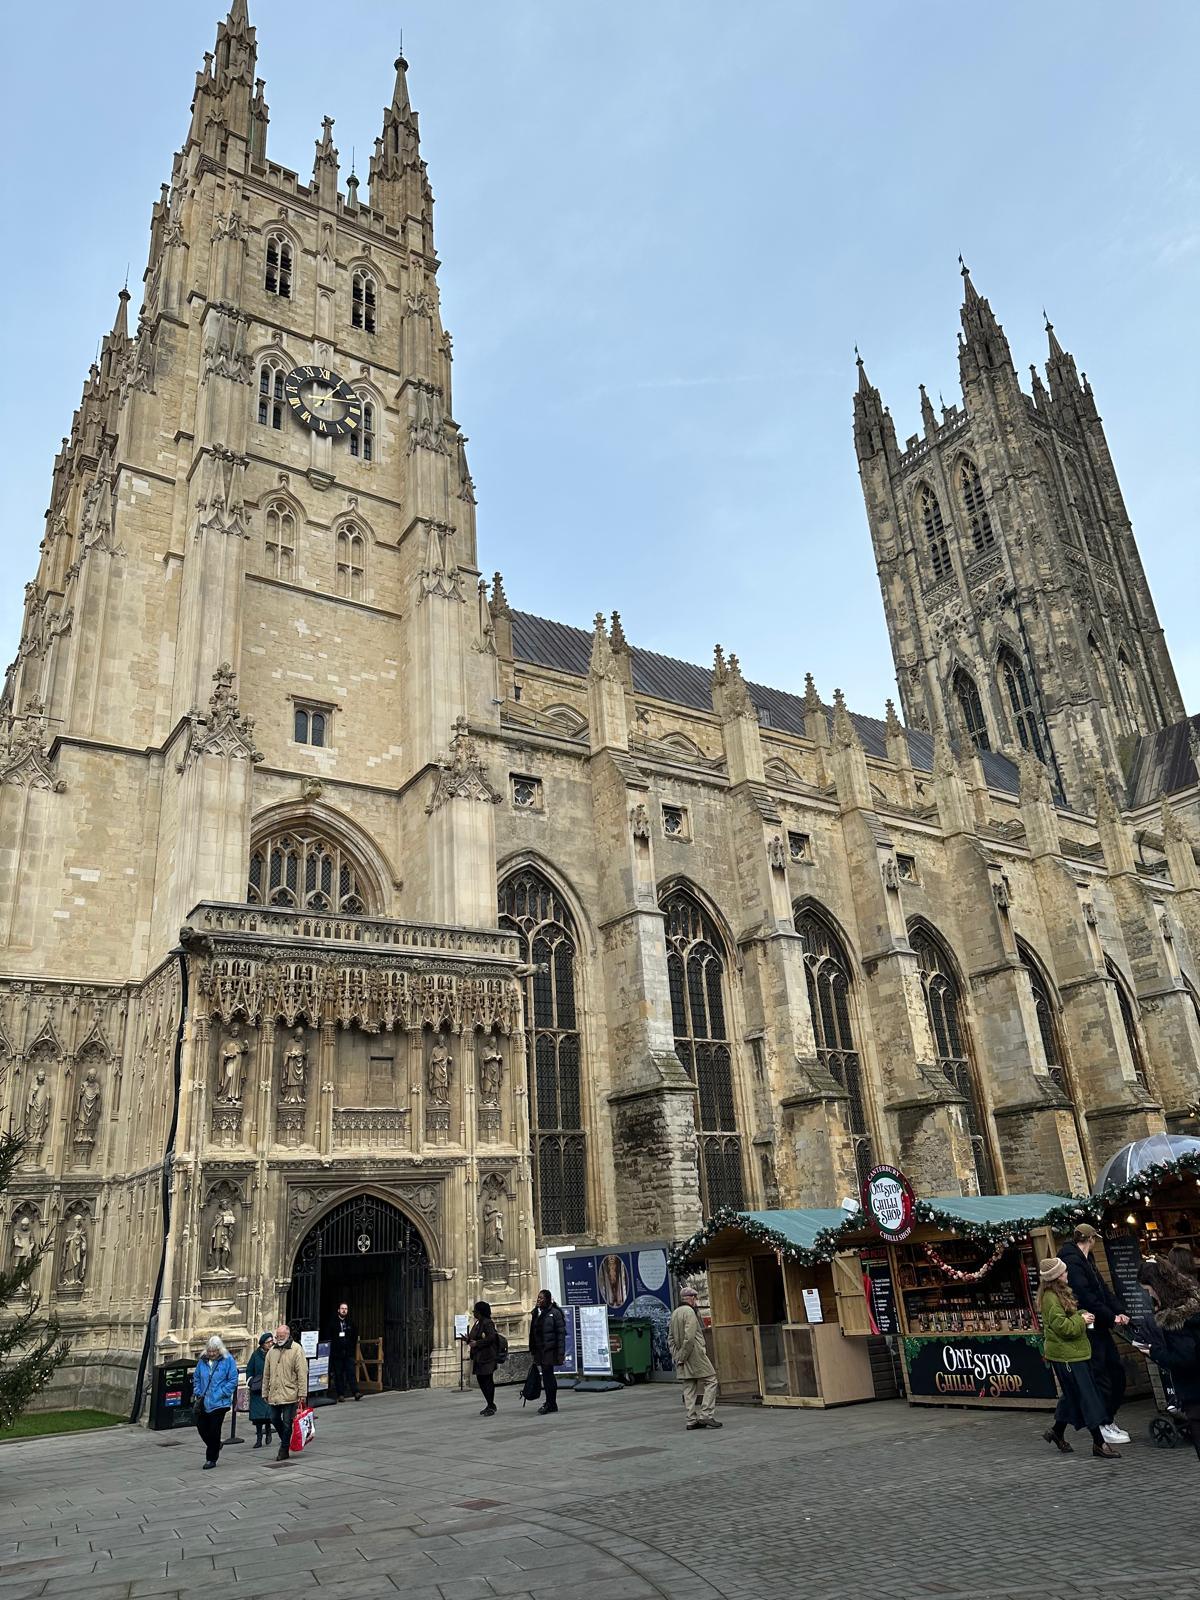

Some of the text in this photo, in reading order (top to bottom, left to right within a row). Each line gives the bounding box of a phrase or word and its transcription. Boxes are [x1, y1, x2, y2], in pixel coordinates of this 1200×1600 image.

[290, 371, 303, 383] X
[336, 424, 344, 433] V
[867, 1166, 900, 1181] CANTERBURY
[870, 1183, 901, 1197] ONE STOP
[873, 1198, 898, 1212] CHILLI
[881, 1210, 901, 1224] SHOP
[880, 1227, 911, 1241] CHILLI SHOP
[943, 1346, 1011, 1380] ONE STOP
[936, 1372, 1023, 1397] CHILLI SHOP
